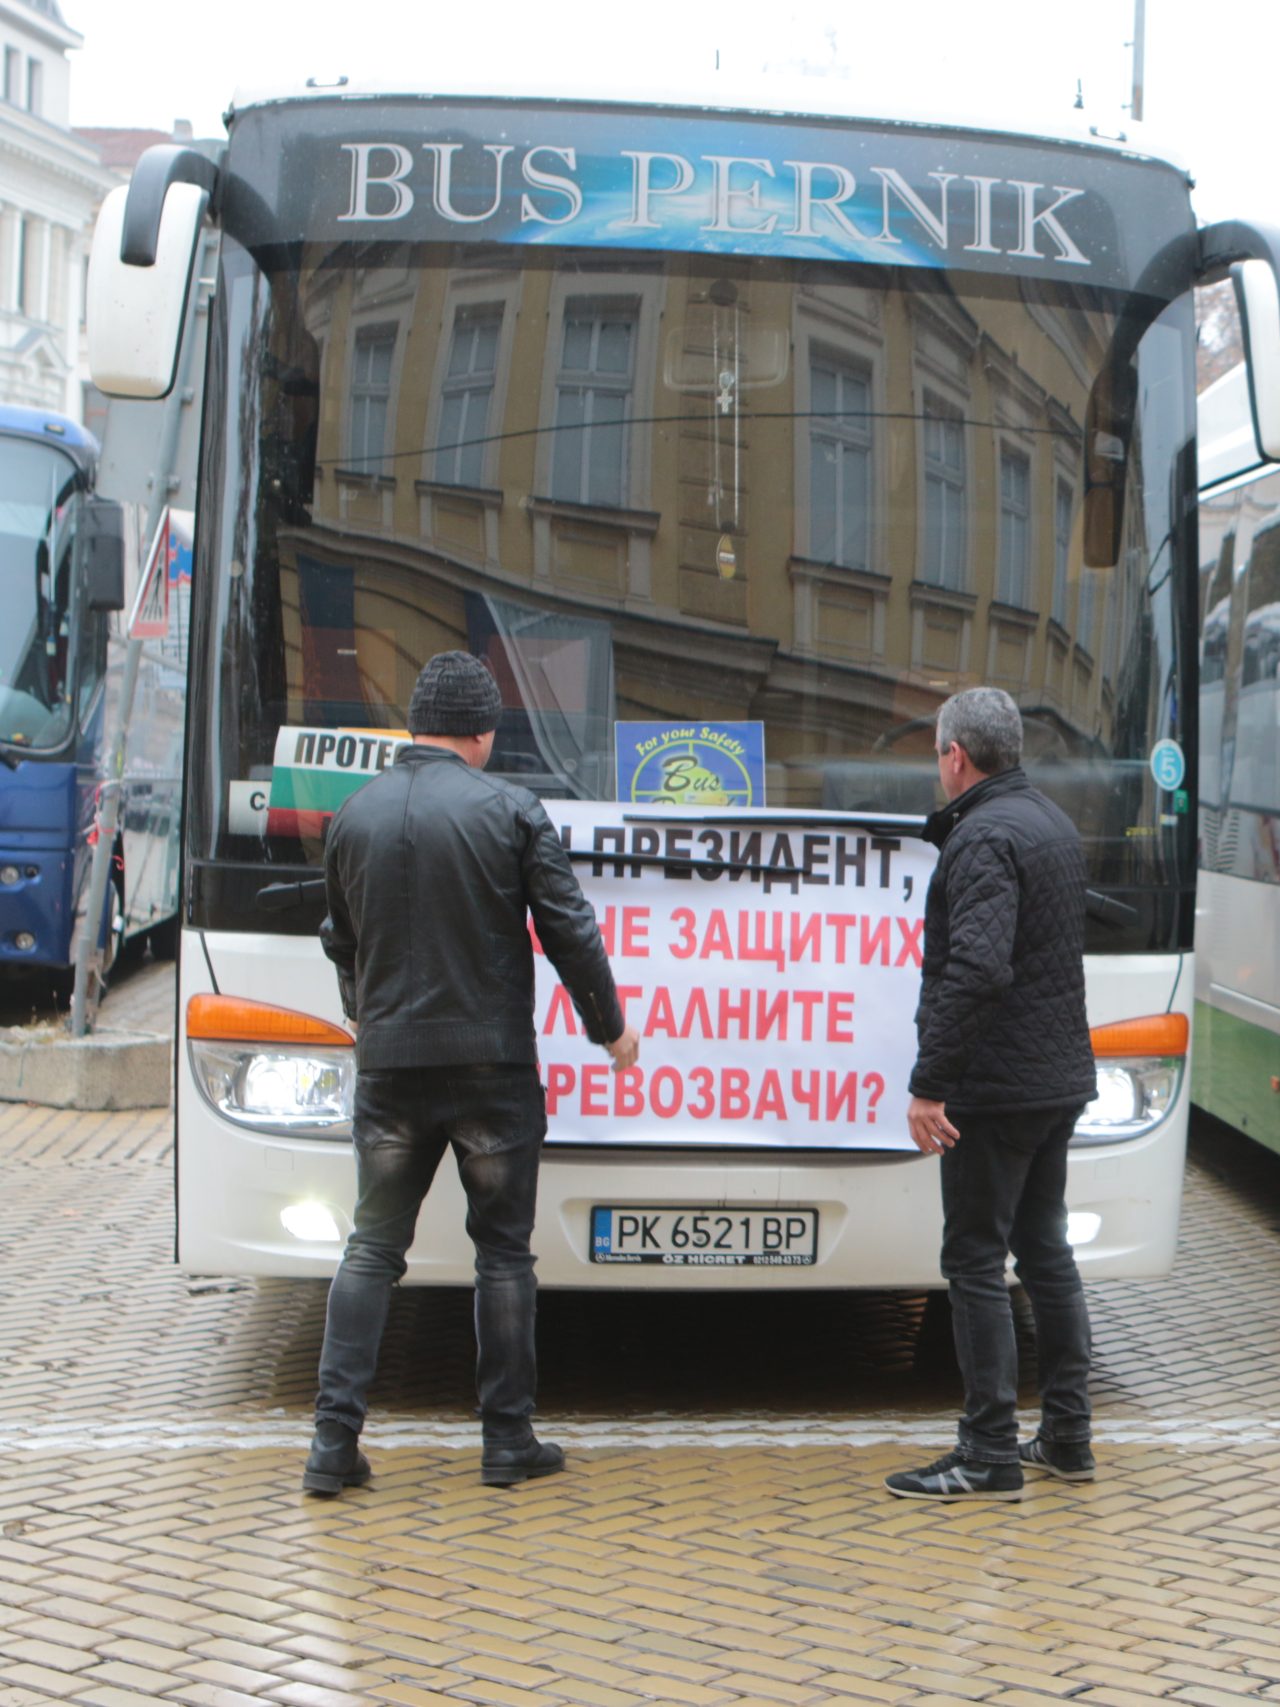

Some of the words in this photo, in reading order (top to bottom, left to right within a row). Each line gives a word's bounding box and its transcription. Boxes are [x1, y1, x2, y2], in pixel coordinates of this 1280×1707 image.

[337, 142, 584, 226] BUS
[616, 149, 1091, 265] PERNIK
[294, 732, 413, 771] ПРОТЕ
[635, 736, 658, 756] For
[661, 728, 695, 743] your
[699, 727, 745, 755] Safety
[592, 826, 914, 902] ПРЕЗИДЕНТ,
[542, 983, 855, 1044] ЛГАЛНИТЕ
[537, 1063, 886, 1124] РЕВОЗВАЧИ?
[594, 1236, 611, 1248] BG
[670, 1215, 751, 1249] 6521
